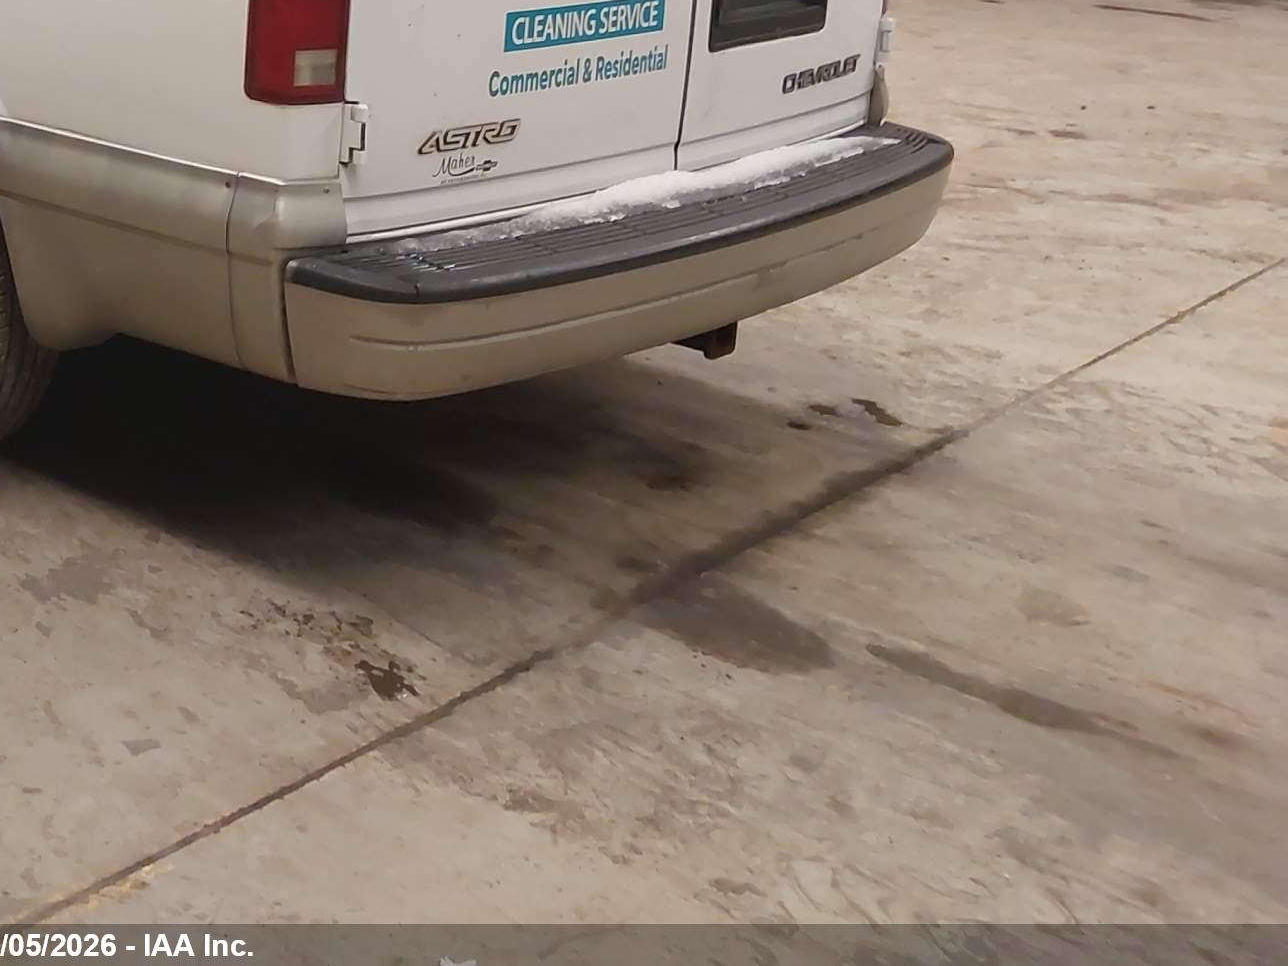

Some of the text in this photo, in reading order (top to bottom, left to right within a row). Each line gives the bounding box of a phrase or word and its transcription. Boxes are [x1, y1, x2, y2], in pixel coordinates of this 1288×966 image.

[511, 0, 659, 46] CLEANING SERVICE
[488, 45, 668, 98] Commercial & Residential
[782, 53, 861, 94] CHEVROLET
[416, 118, 521, 155] ASTRO
